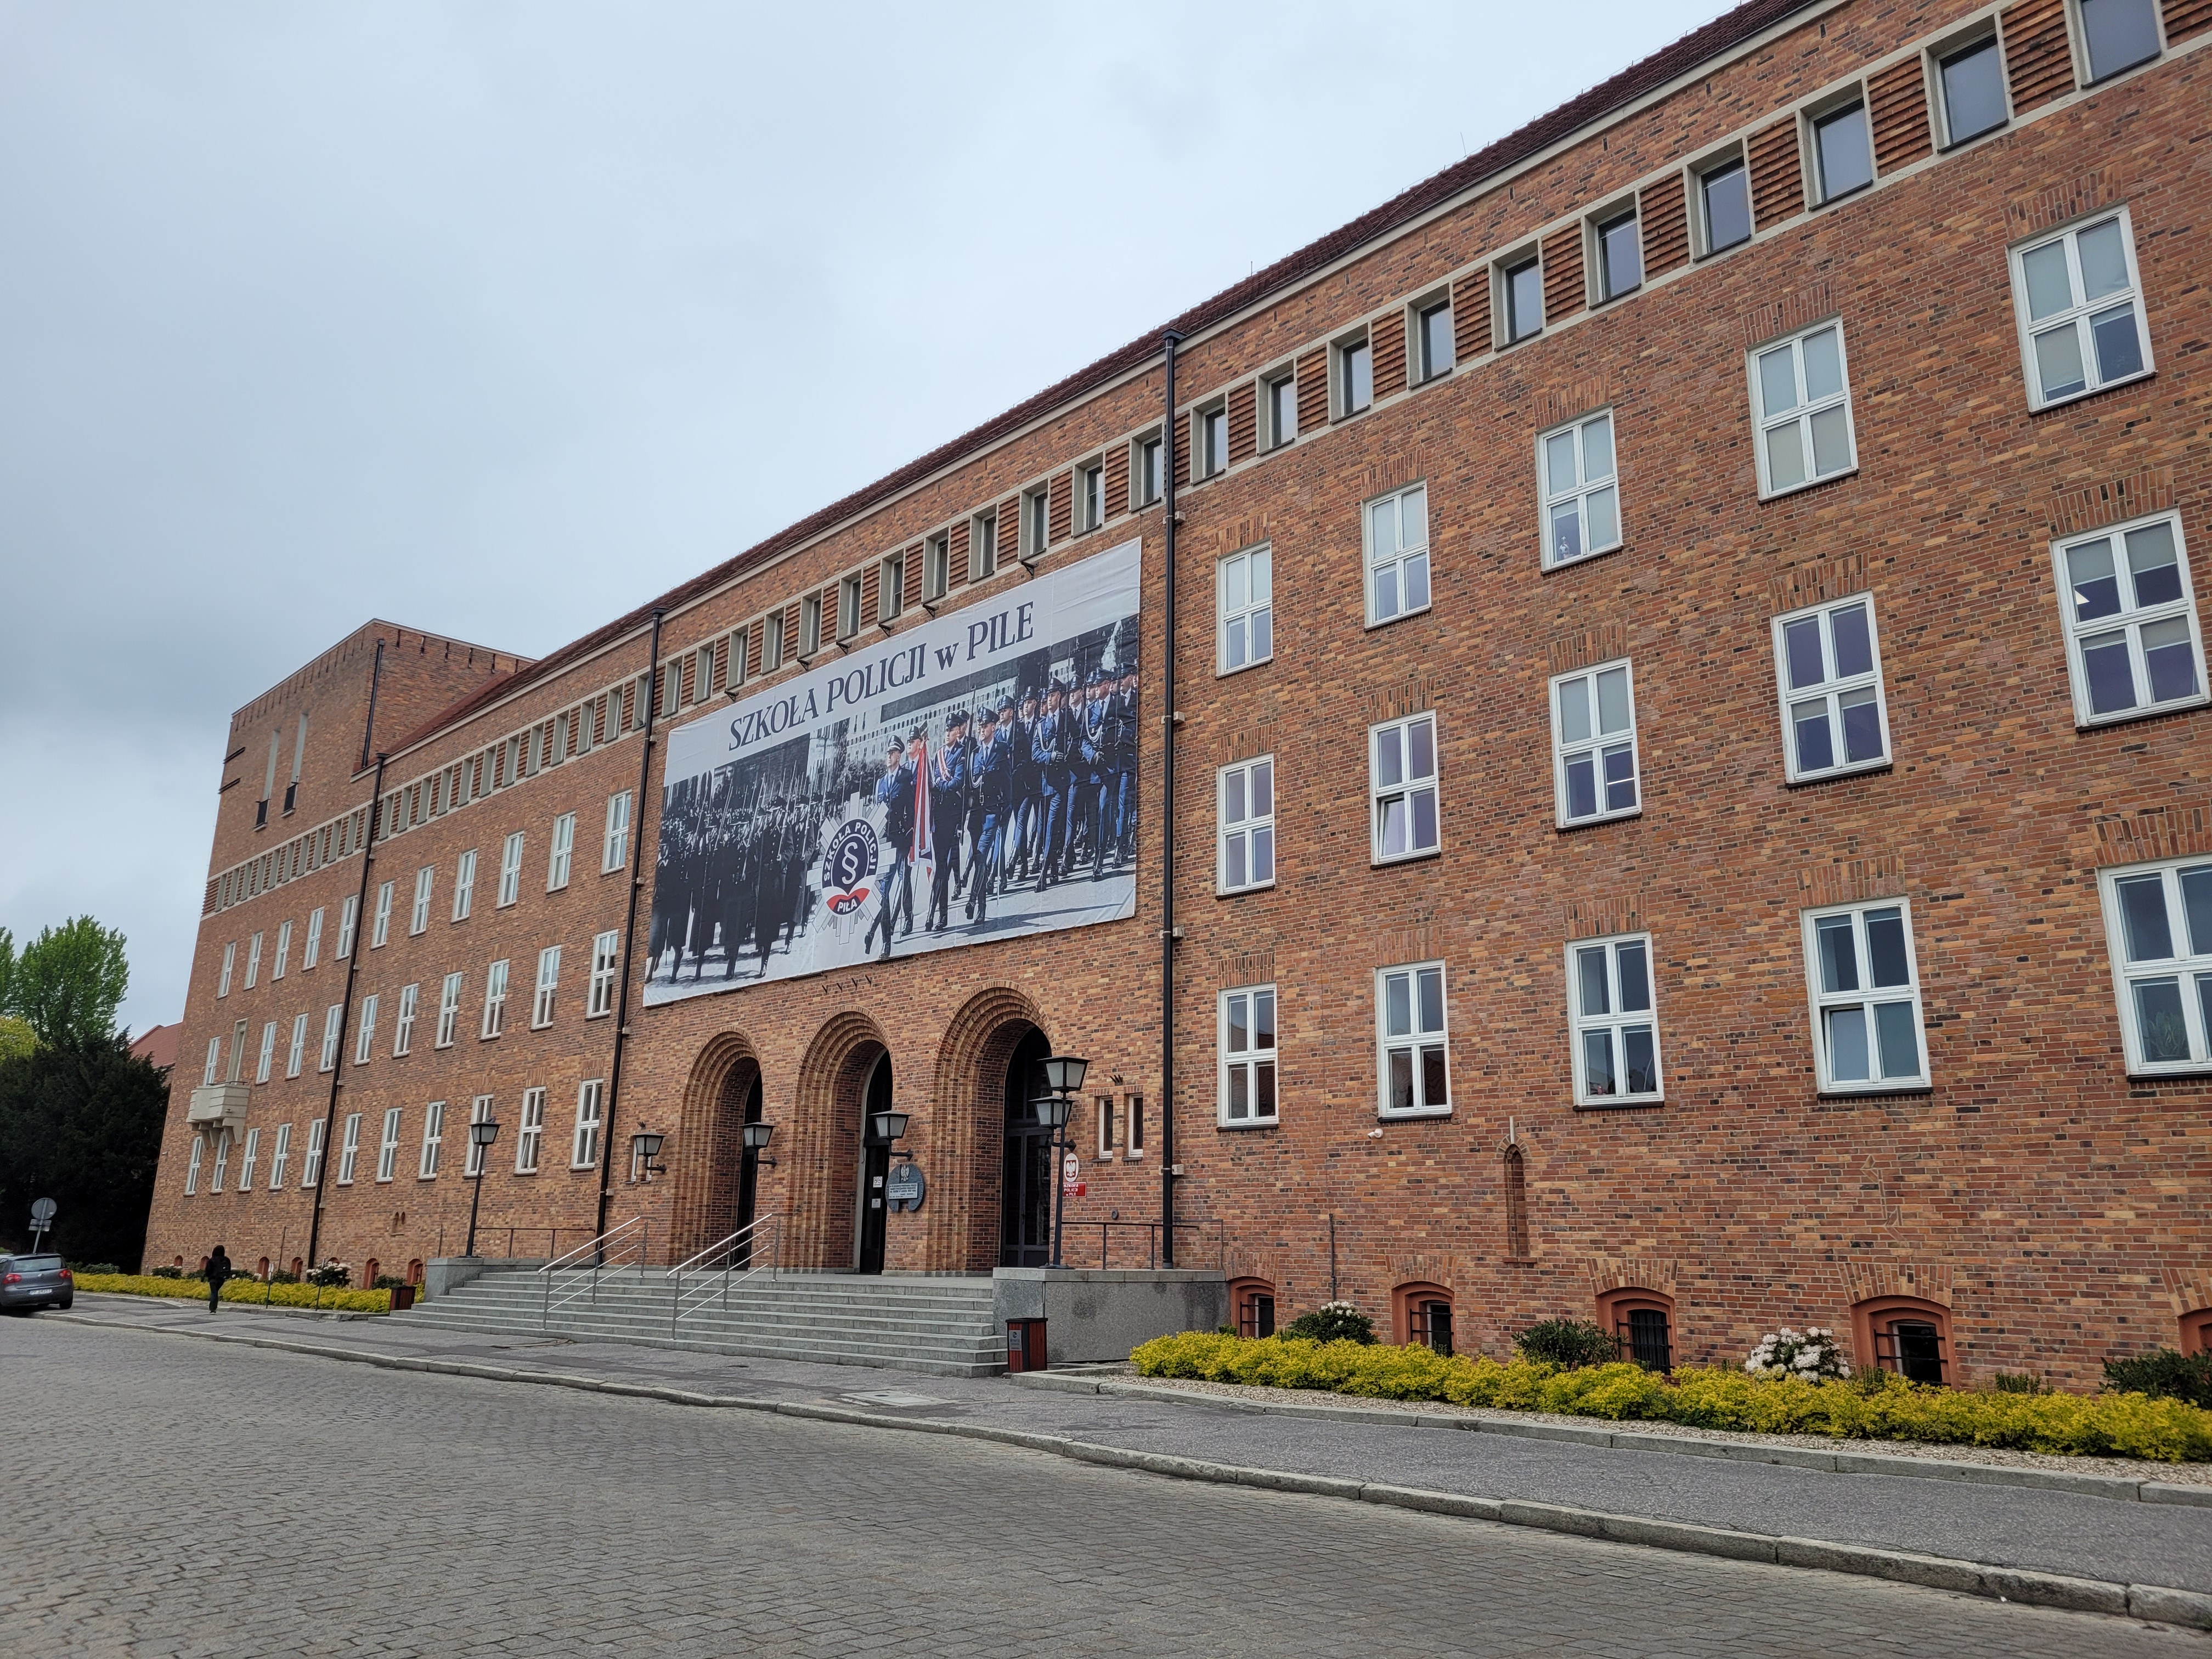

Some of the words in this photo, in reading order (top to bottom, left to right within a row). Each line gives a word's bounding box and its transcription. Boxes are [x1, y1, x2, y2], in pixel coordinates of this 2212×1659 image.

[729, 687, 819, 752] SZKOŁA
[826, 642, 927, 714] POLICJI
[934, 642, 959, 670] w
[967, 601, 1034, 661] PILE
[824, 826, 851, 882] SZKOŁA
[855, 822, 877, 869] POLICJI
[837, 898, 857, 913] PIŁA
